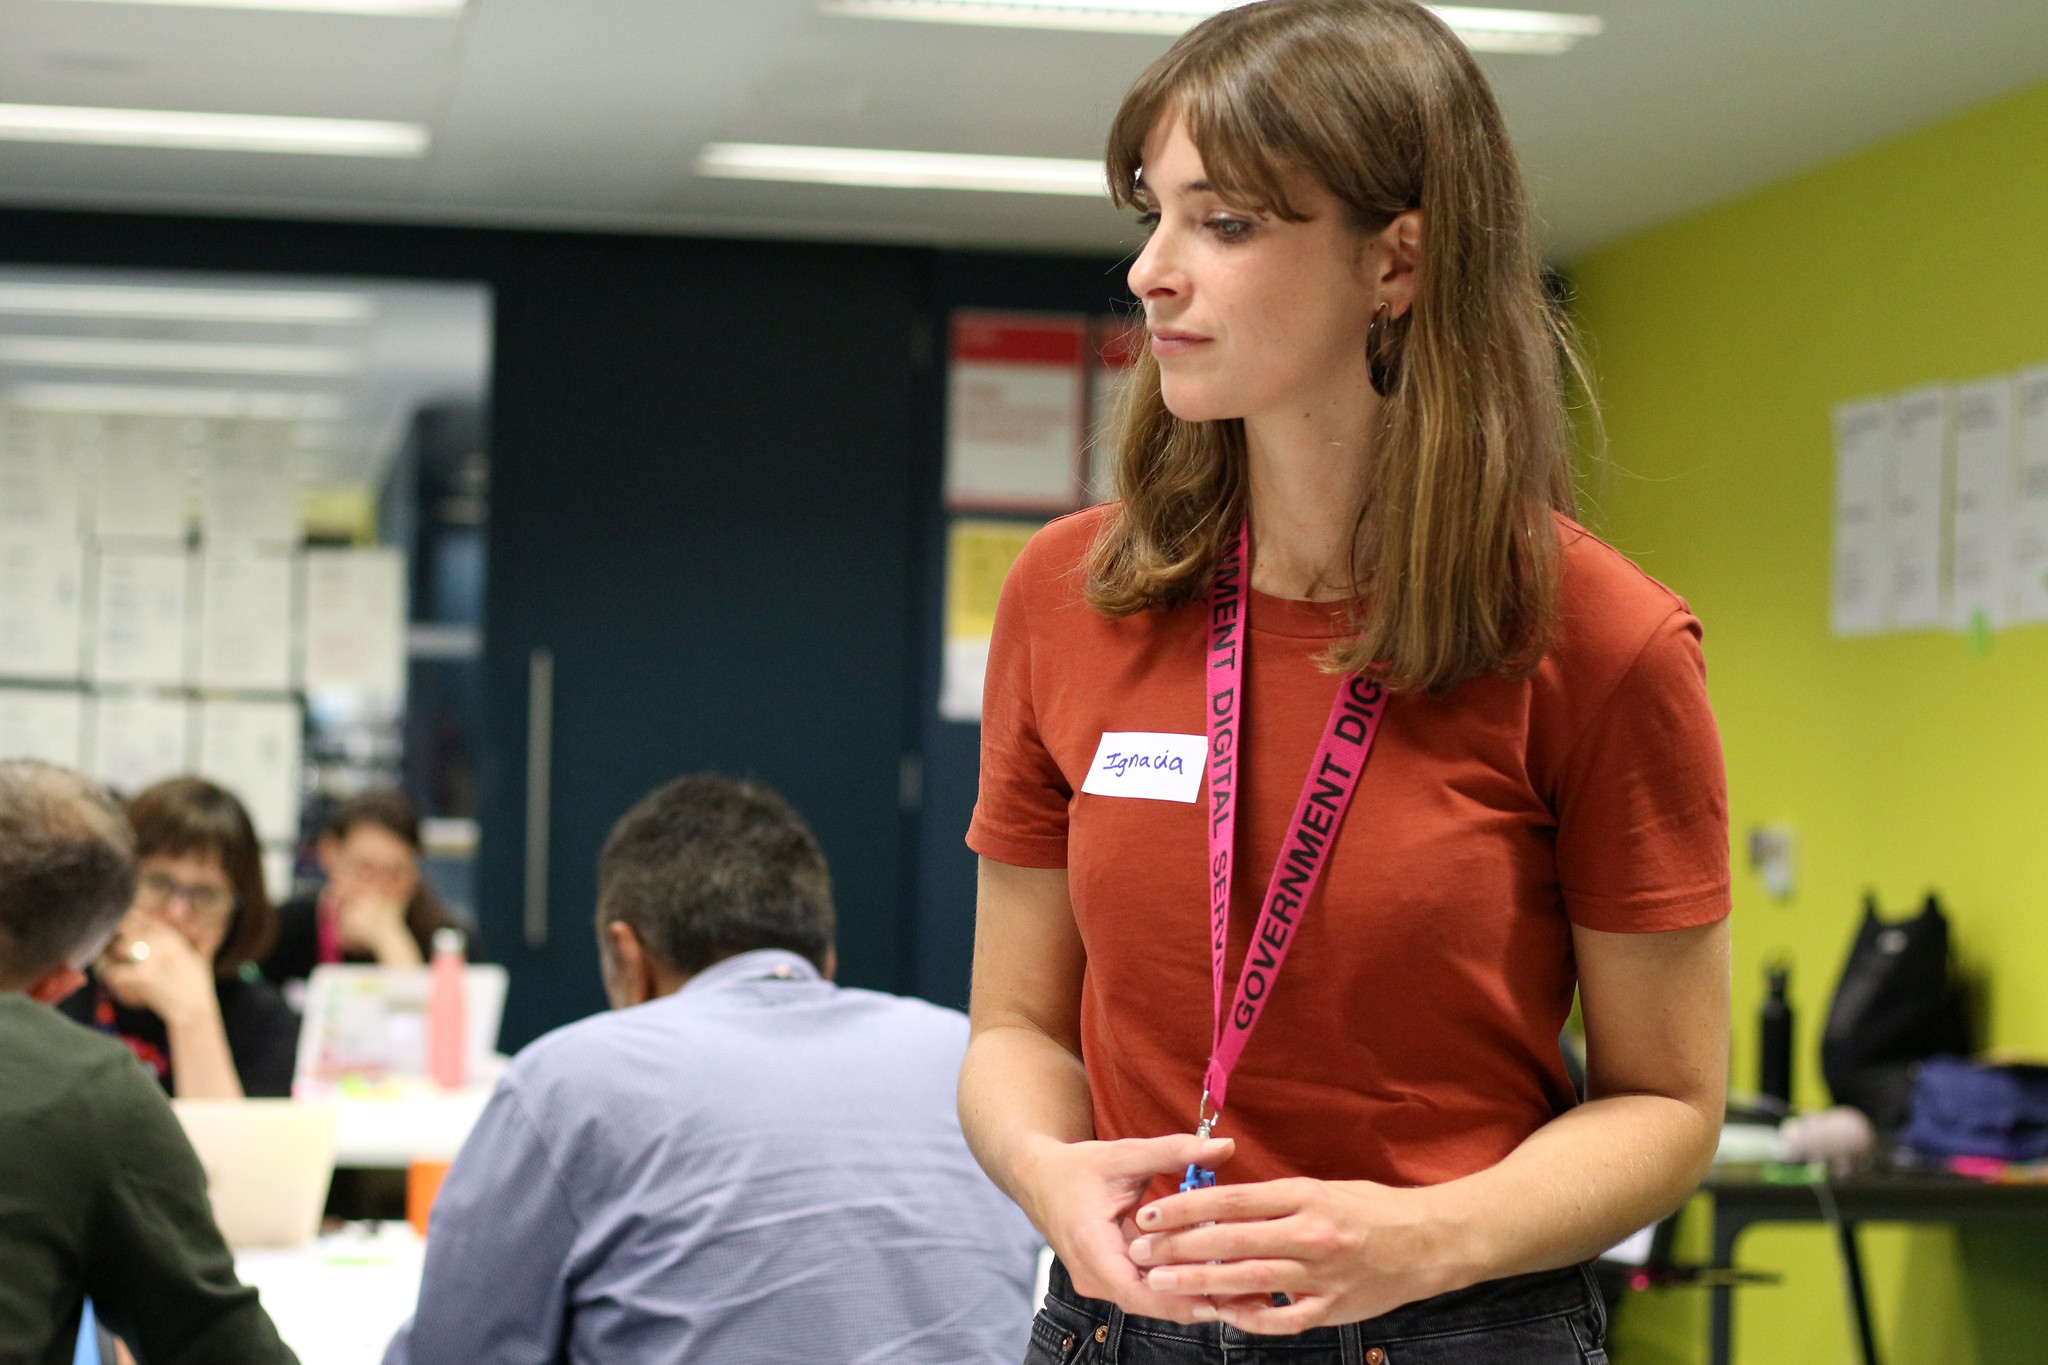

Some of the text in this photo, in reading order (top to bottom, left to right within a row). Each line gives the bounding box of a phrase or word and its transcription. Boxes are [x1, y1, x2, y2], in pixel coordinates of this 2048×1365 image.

[1102, 749, 1183, 777] Ignacia
[1212, 687, 1235, 840] DIGITAL
[1234, 676, 1383, 1031] GOVERNMENT DIG
